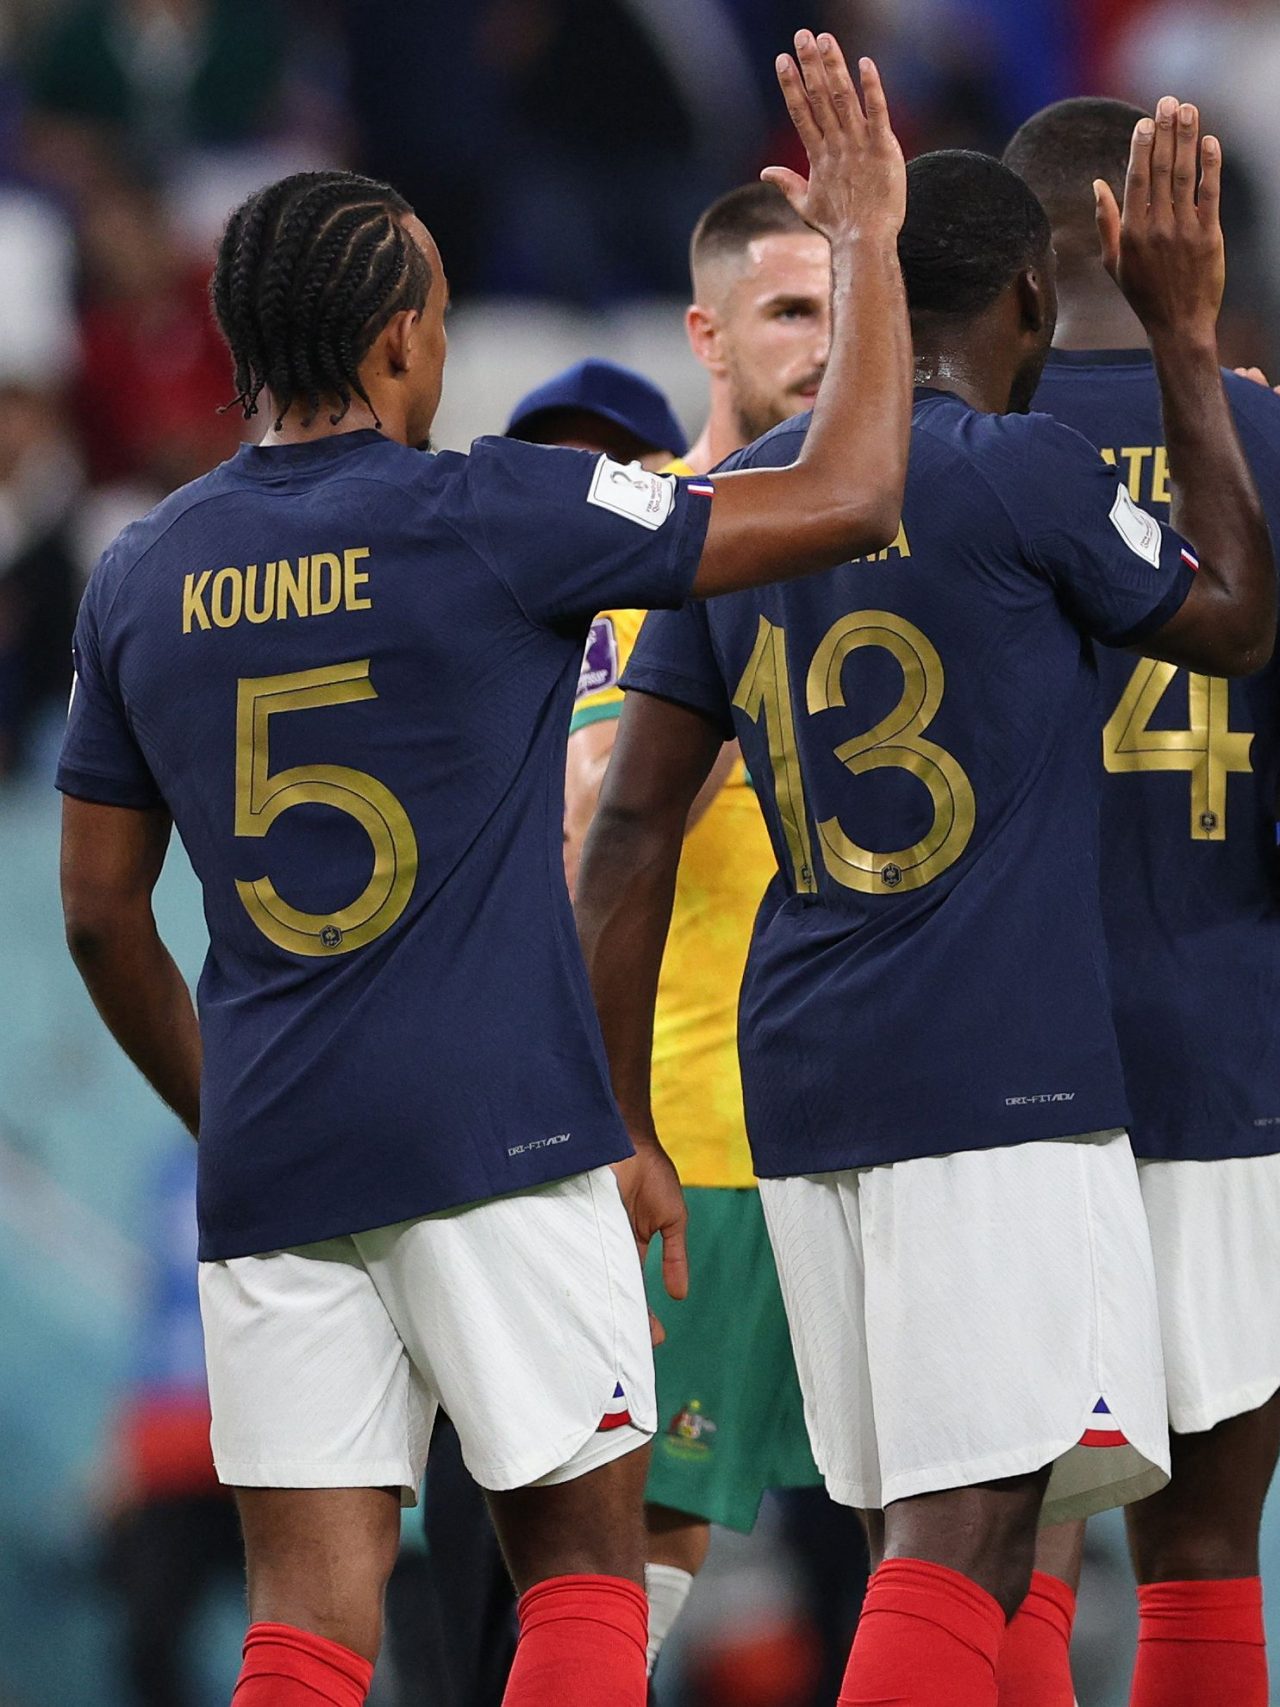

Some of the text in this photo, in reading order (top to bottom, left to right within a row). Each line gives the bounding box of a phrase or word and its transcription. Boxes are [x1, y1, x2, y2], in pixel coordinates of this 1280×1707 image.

[182, 546, 372, 634] KOUNDE
[234, 658, 419, 957] 5
[731, 608, 977, 894] 13
